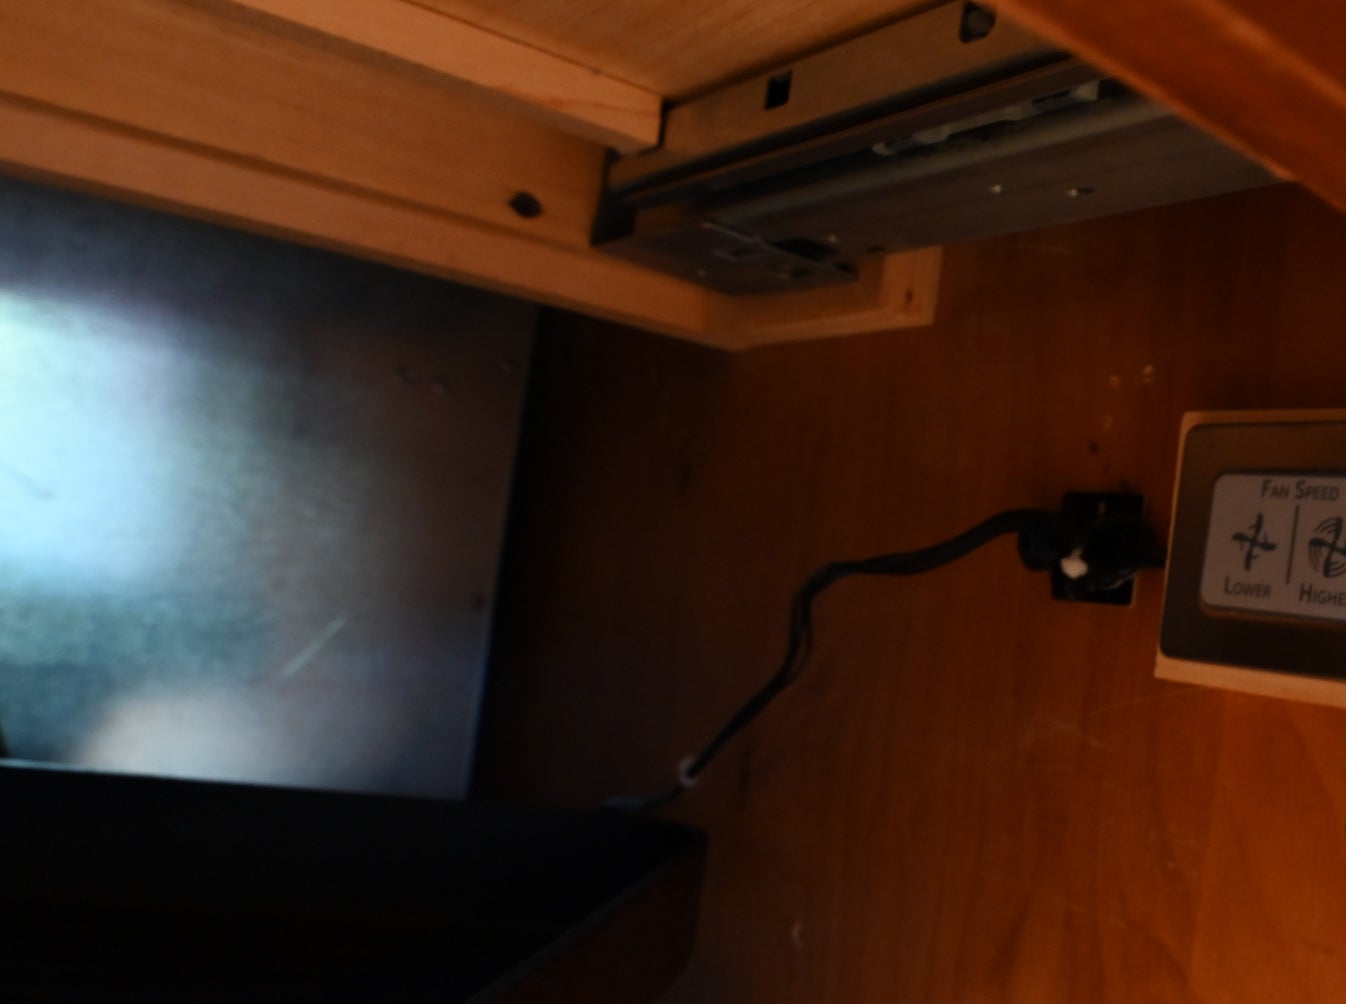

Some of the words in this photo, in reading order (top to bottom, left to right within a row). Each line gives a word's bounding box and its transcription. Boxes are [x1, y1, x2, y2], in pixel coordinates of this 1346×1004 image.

[1260, 479, 1290, 498] FAN
[1294, 480, 1340, 501] SPEED
[1224, 576, 1272, 598] LOWER
